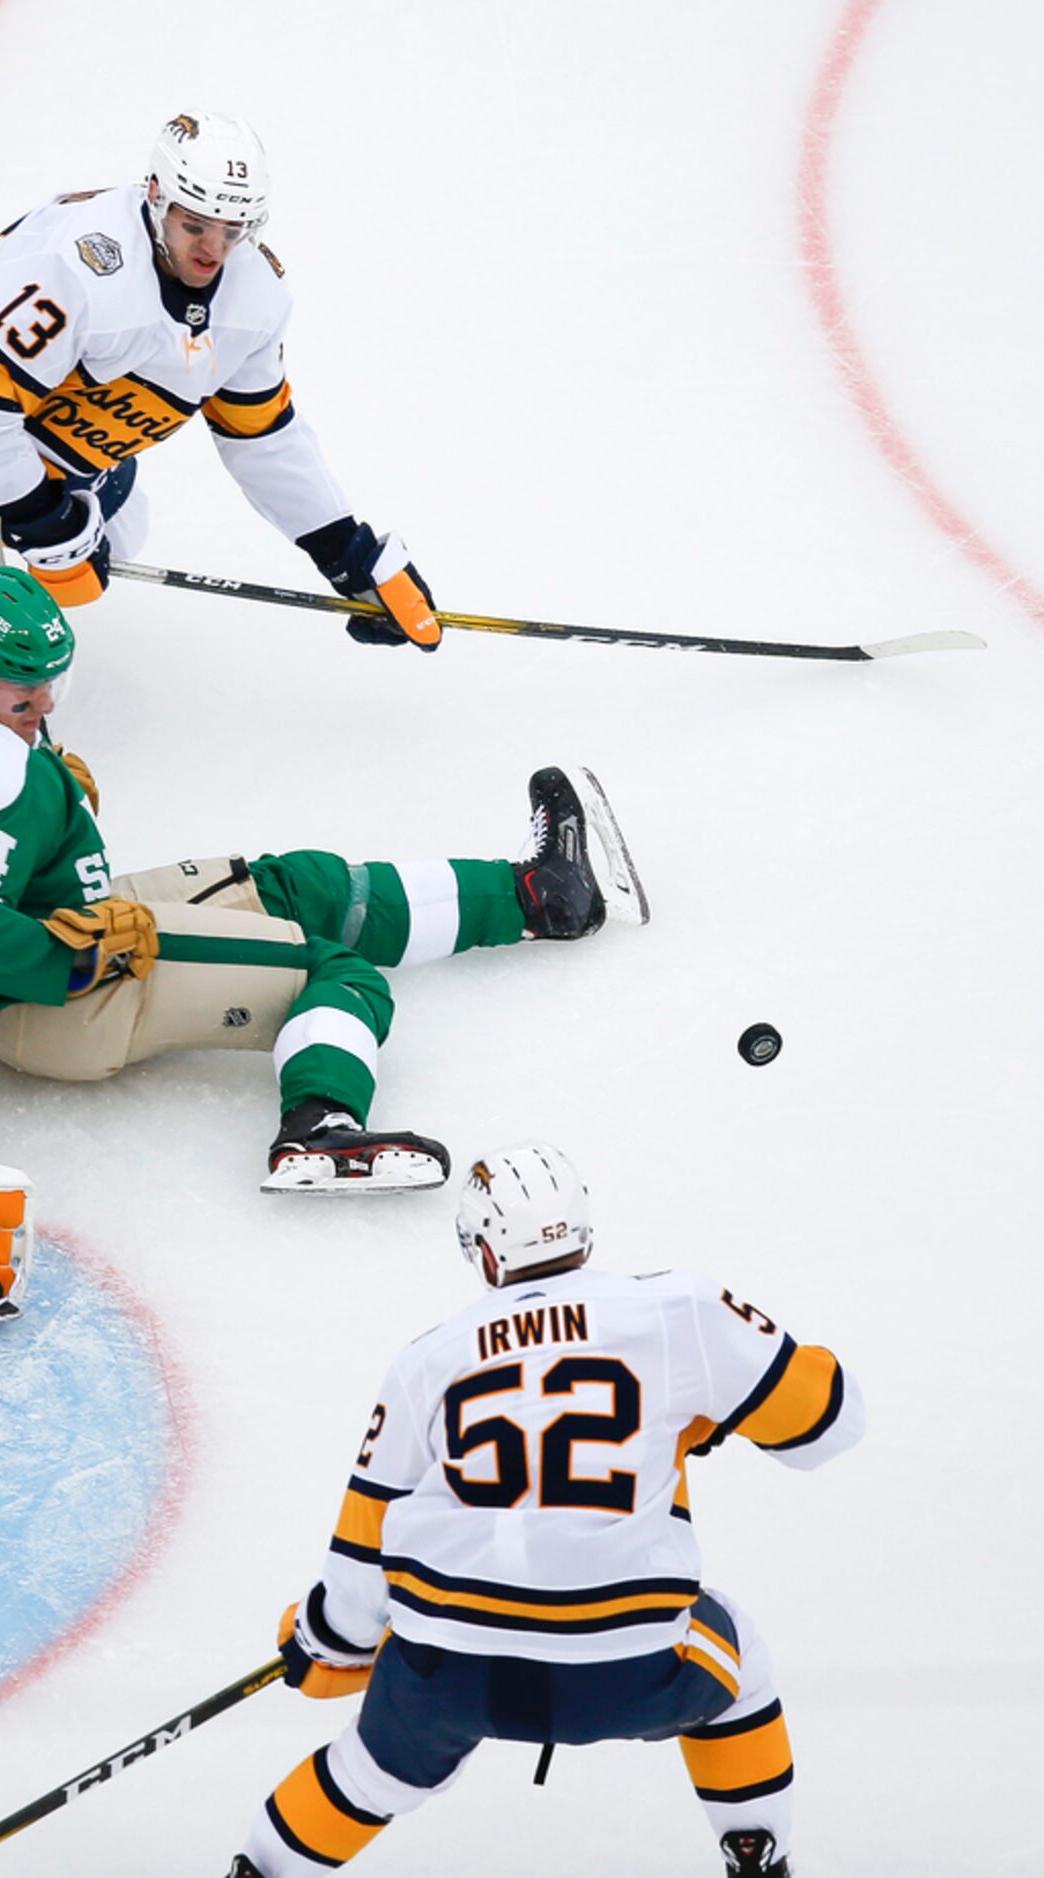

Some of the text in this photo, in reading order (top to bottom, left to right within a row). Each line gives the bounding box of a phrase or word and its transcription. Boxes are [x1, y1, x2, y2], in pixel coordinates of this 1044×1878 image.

[226, 160, 248, 179] 13
[216, 193, 253, 204] CCM
[184, 574, 243, 592] CCM
[541, 1221, 568, 1244] 52
[477, 1303, 589, 1361] IRWIN
[442, 1356, 642, 1515] 52
[63, 1715, 192, 1802] CCM
